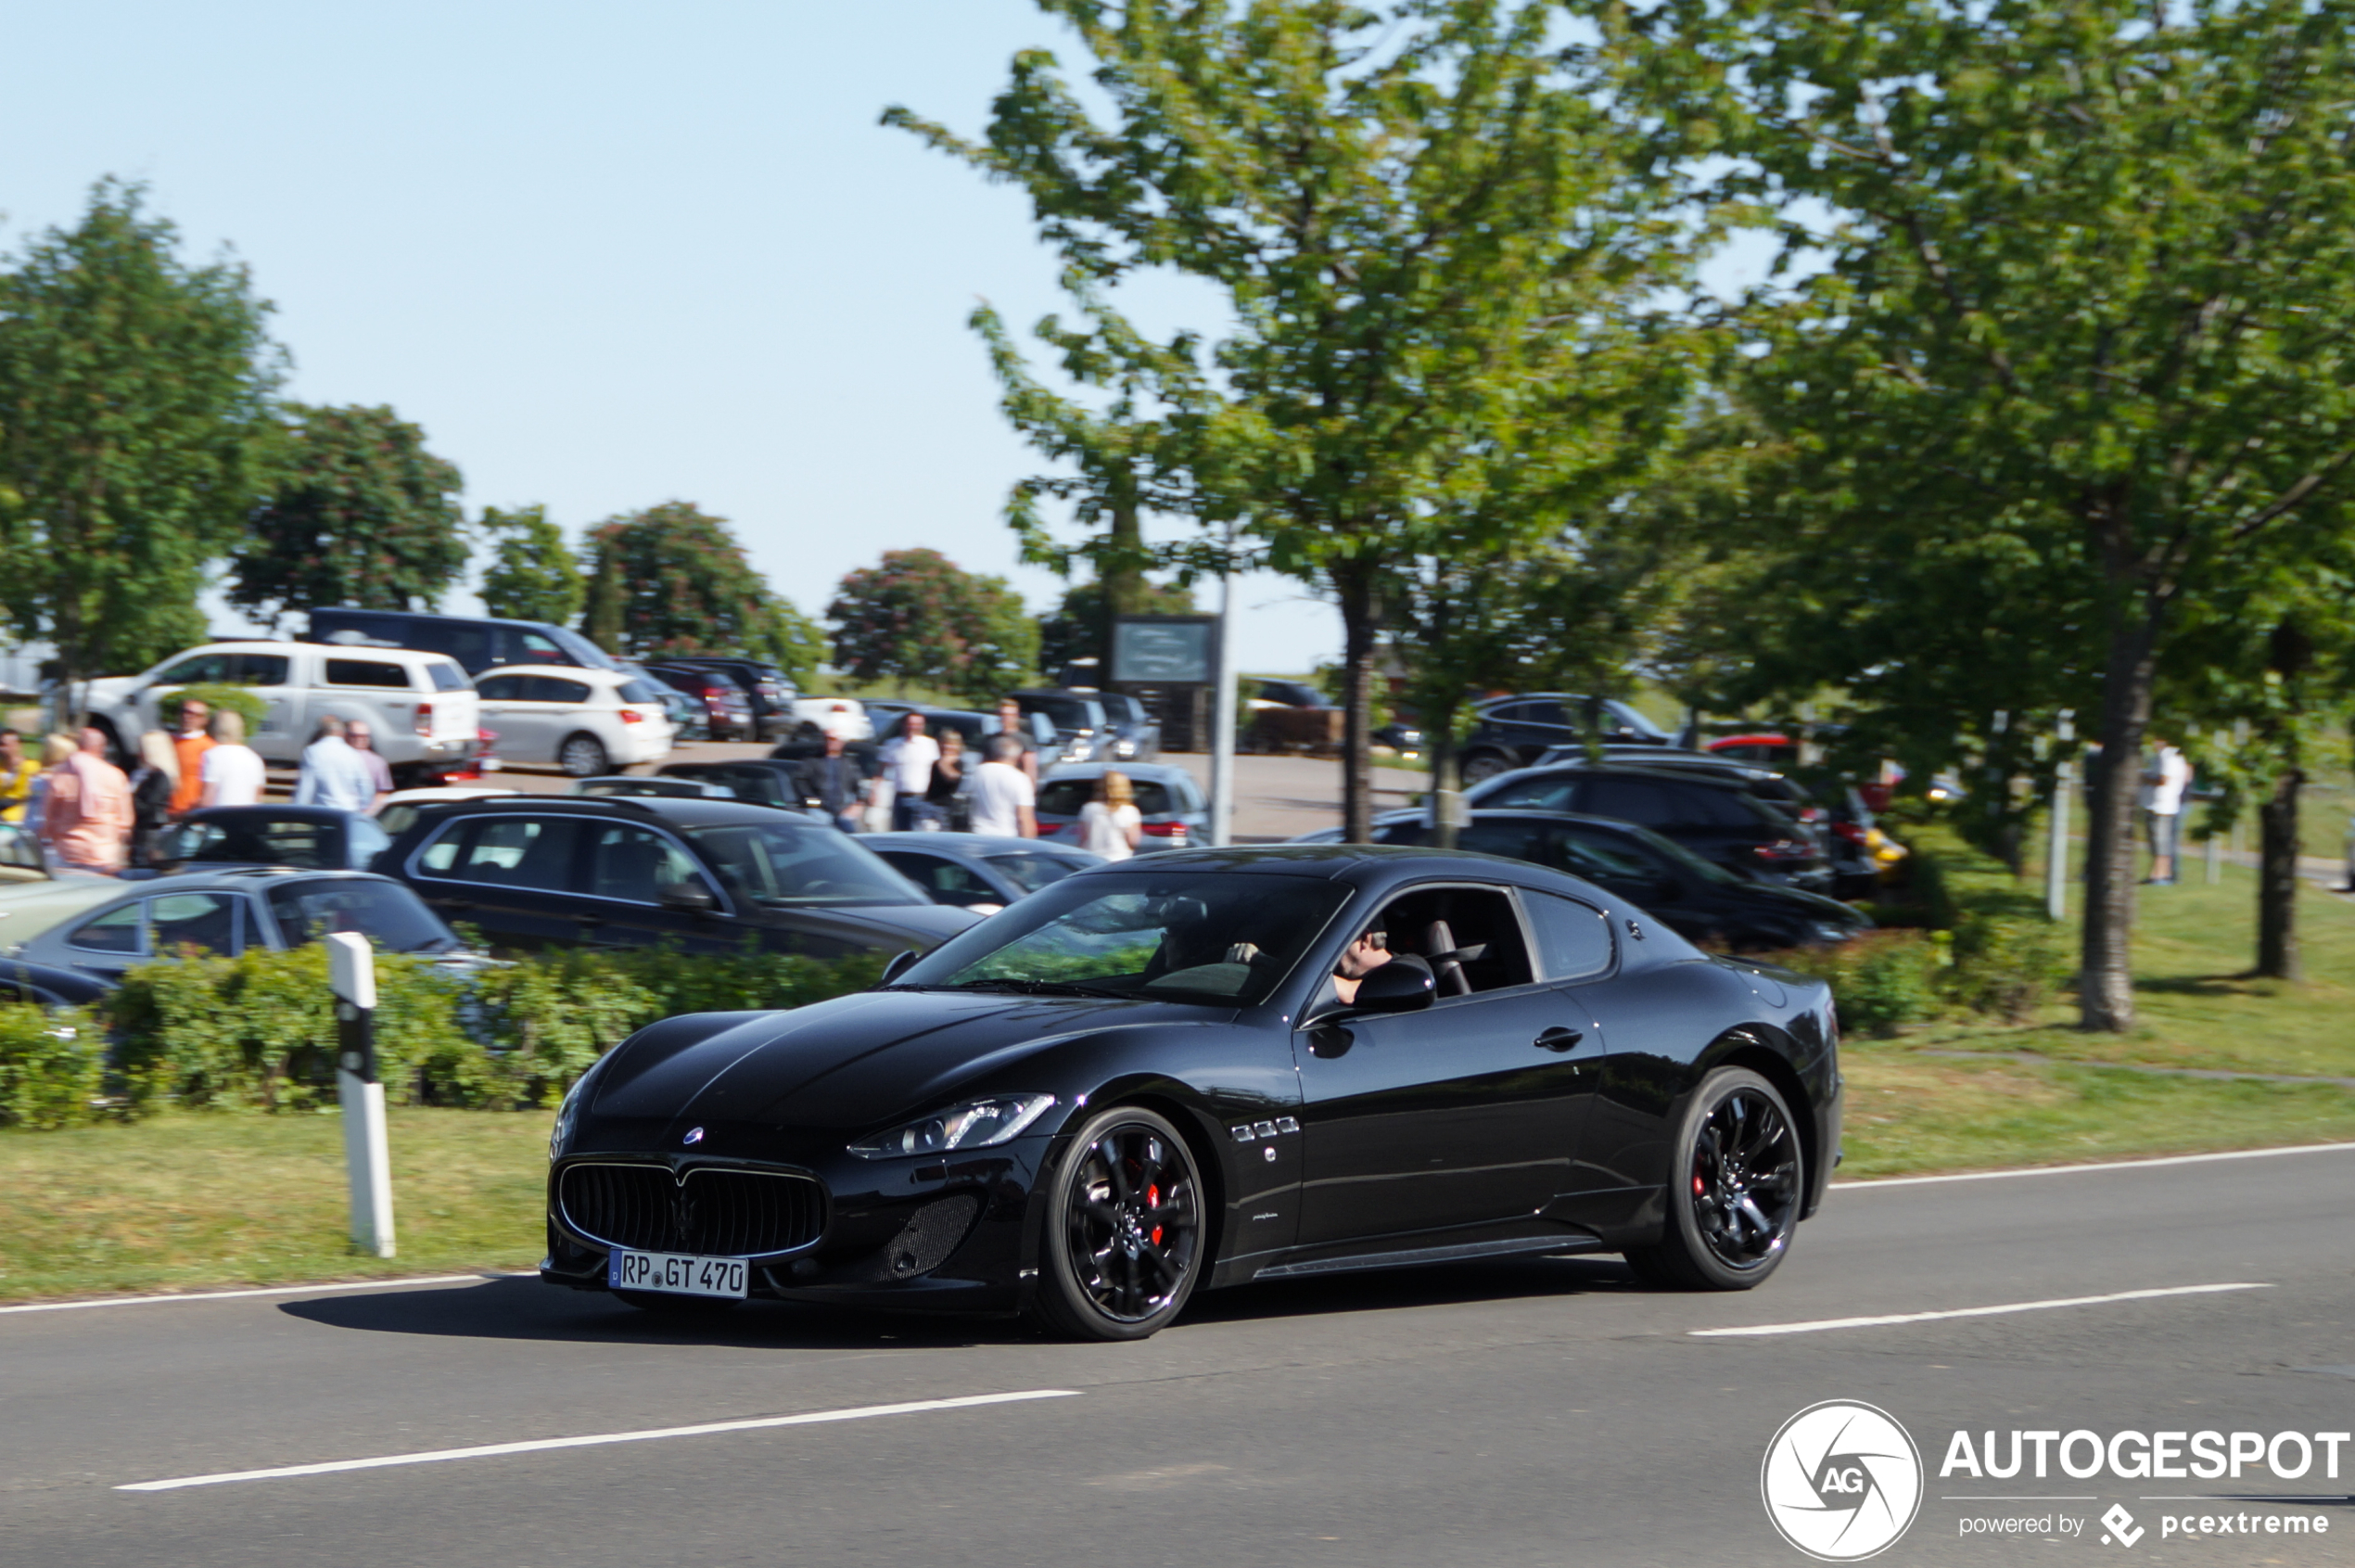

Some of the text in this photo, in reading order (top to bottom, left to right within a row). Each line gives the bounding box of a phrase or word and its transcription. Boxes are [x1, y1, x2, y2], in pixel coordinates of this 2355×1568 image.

[622, 1255, 744, 1292] RP GT 470
